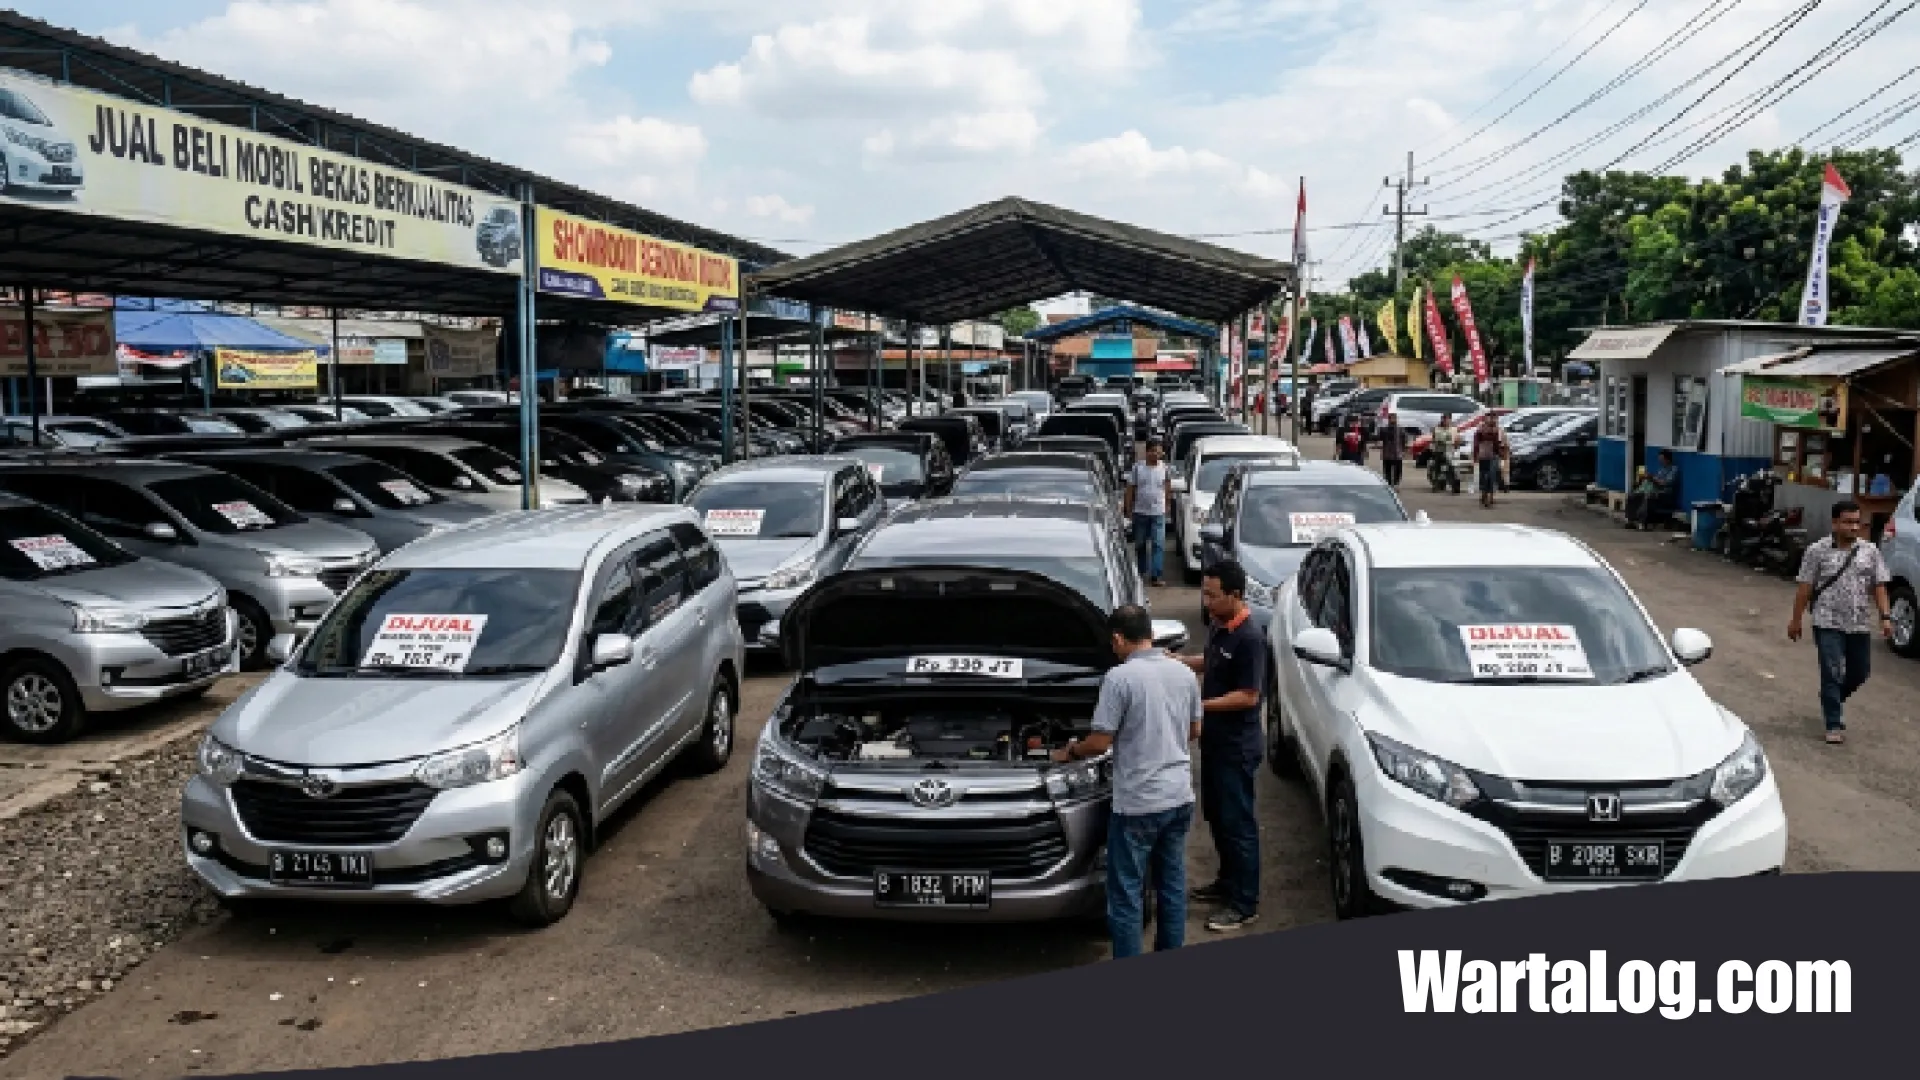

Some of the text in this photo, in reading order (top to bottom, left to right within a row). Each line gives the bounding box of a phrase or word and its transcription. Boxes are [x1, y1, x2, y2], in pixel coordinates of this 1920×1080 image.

[88, 105, 165, 166] JUAL
[173, 124, 229, 179] BELI
[236, 138, 304, 193] MOBIL
[309, 156, 370, 204] BEKAS
[553, 219, 637, 273] SHOWROOM
[387, 616, 475, 631] DIJUAL
[1468, 626, 1571, 640] DIJUAL
[274, 853, 285, 872] B
[1550, 845, 1563, 866] B
[878, 873, 890, 893] B
[901, 875, 943, 893] 1832
